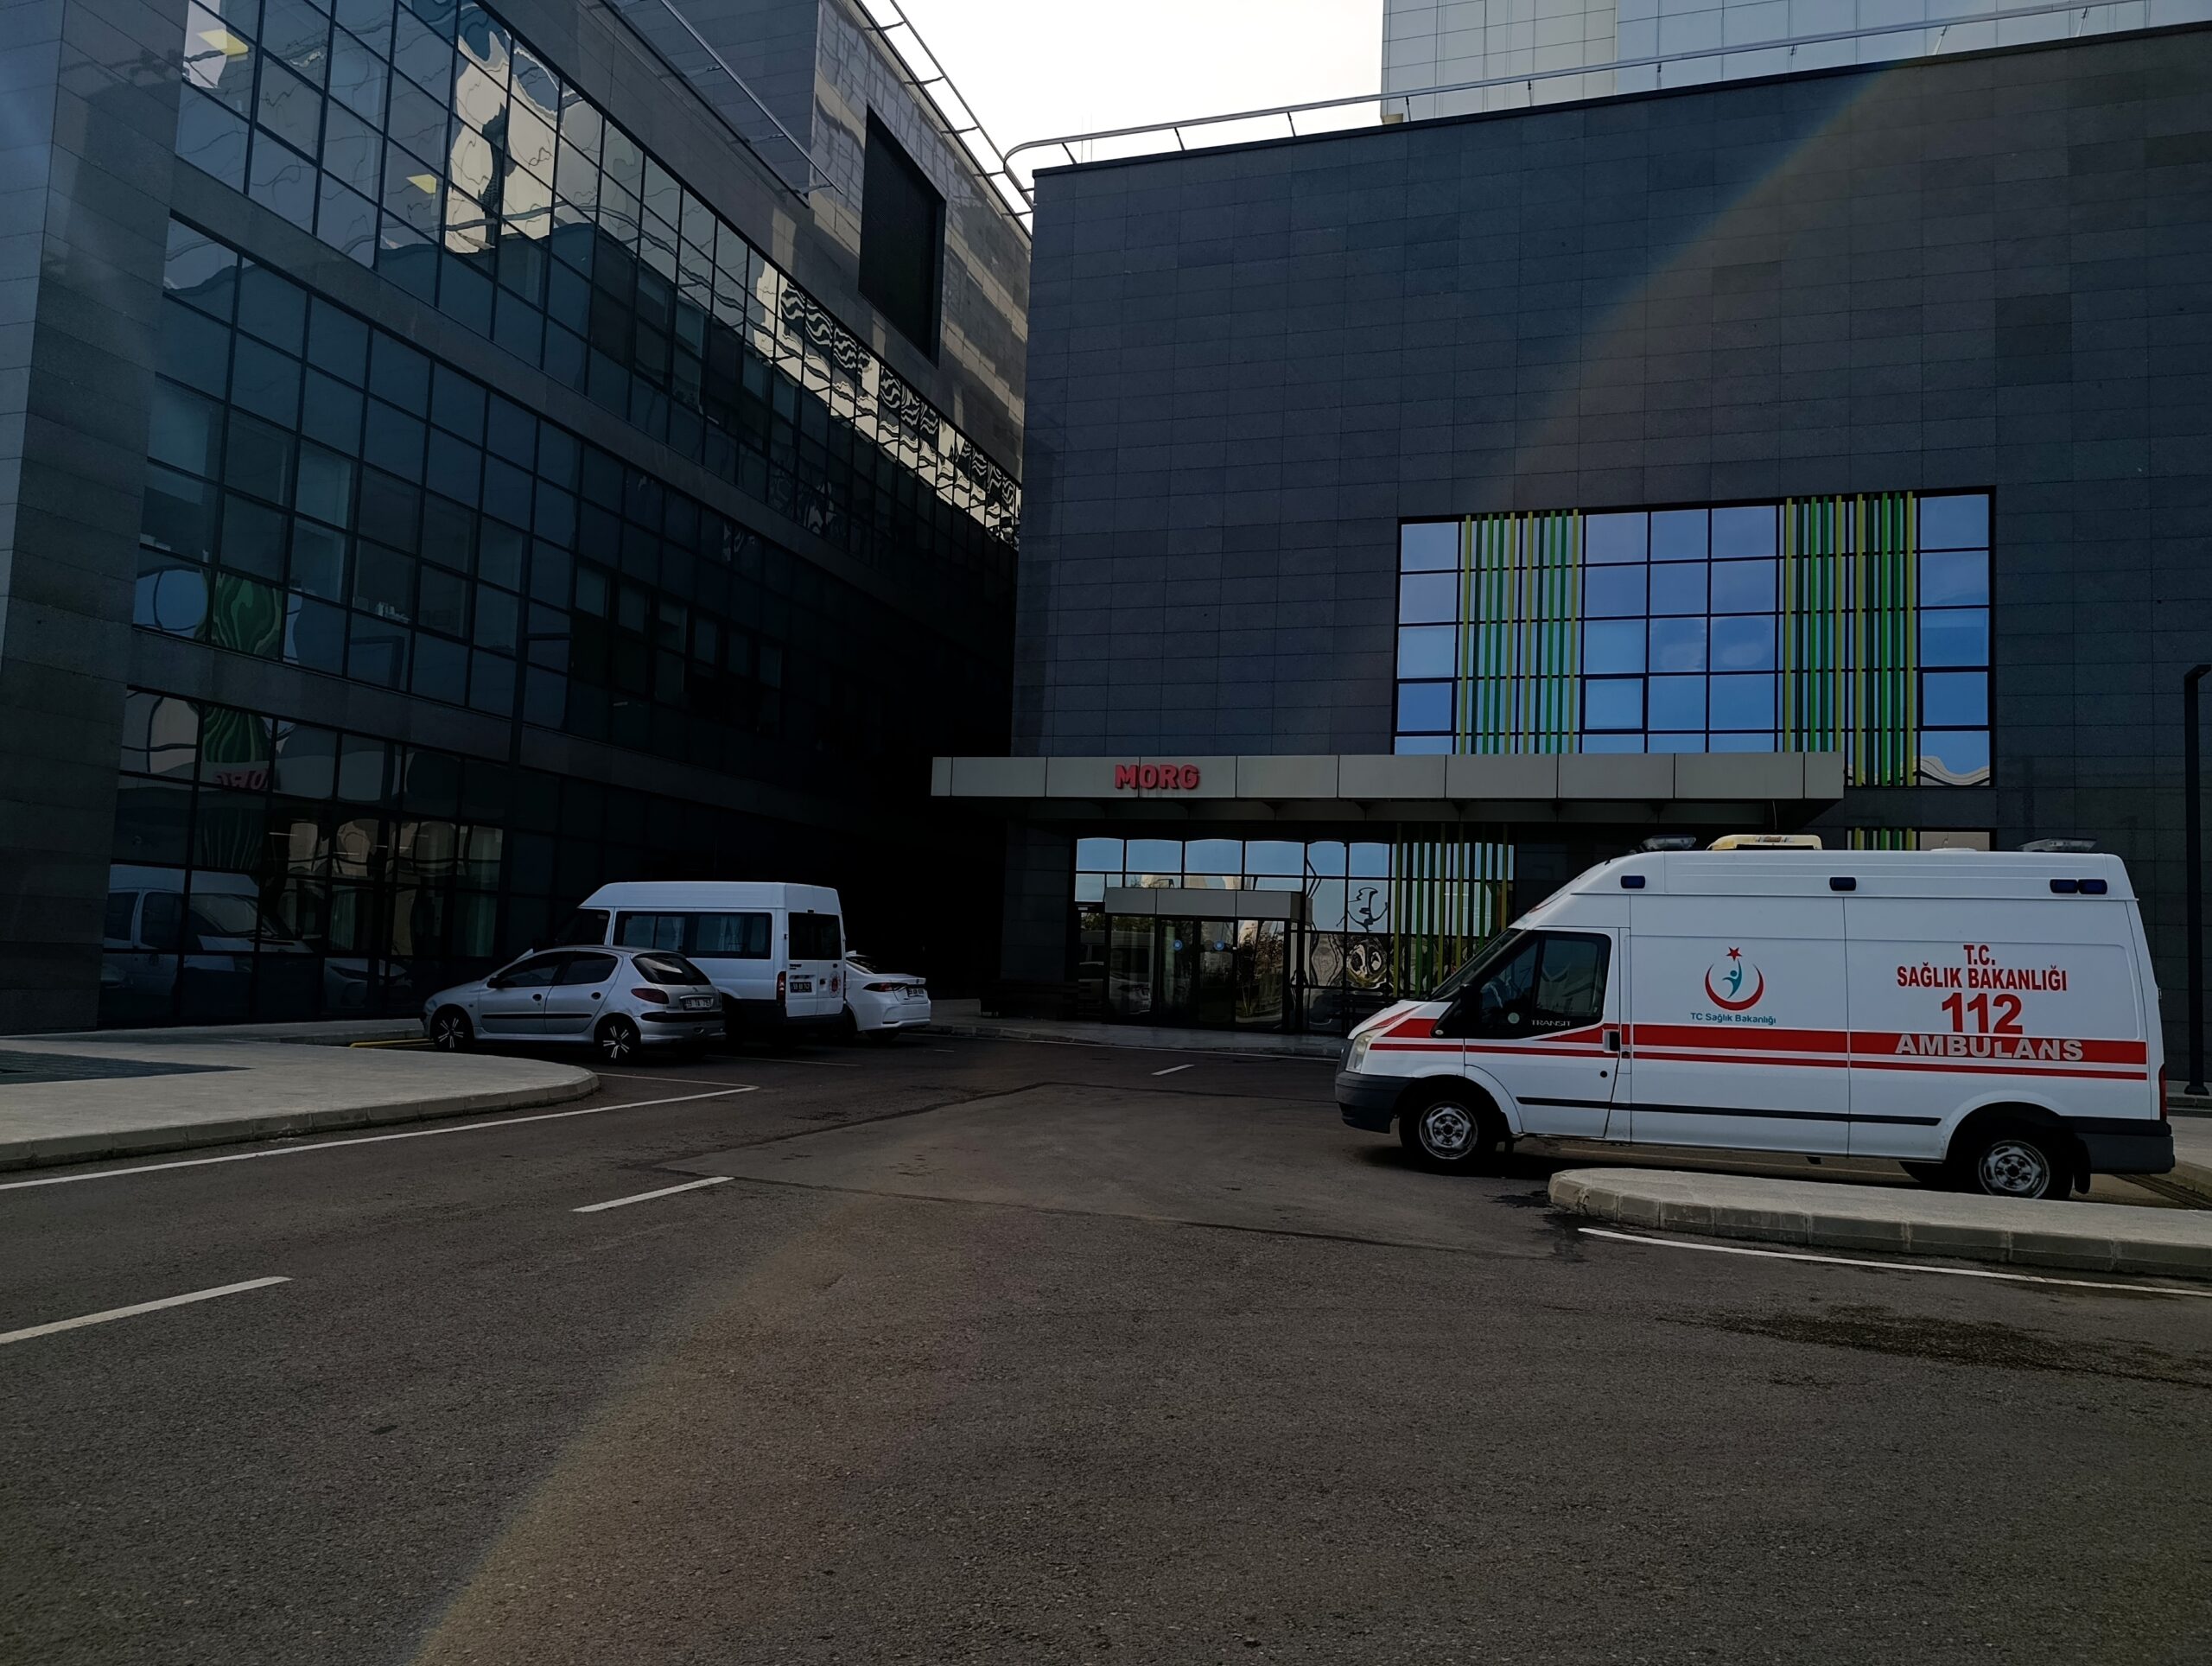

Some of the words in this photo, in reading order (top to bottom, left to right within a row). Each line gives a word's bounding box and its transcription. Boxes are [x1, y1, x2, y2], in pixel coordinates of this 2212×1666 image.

[1115, 764, 1200, 789] MORG
[1963, 944, 1996, 965] T.C.
[1897, 962, 1962, 988] SAĞLIK
[1967, 965, 2067, 991] BAKANLIĞI
[1690, 1012, 1703, 1021] TC
[1706, 1013, 1733, 1023] Sağlık
[1735, 1014, 1777, 1026] Bakanlığı
[1942, 992, 2024, 1035] 112
[1894, 1033, 2084, 1061] AMBULANS
